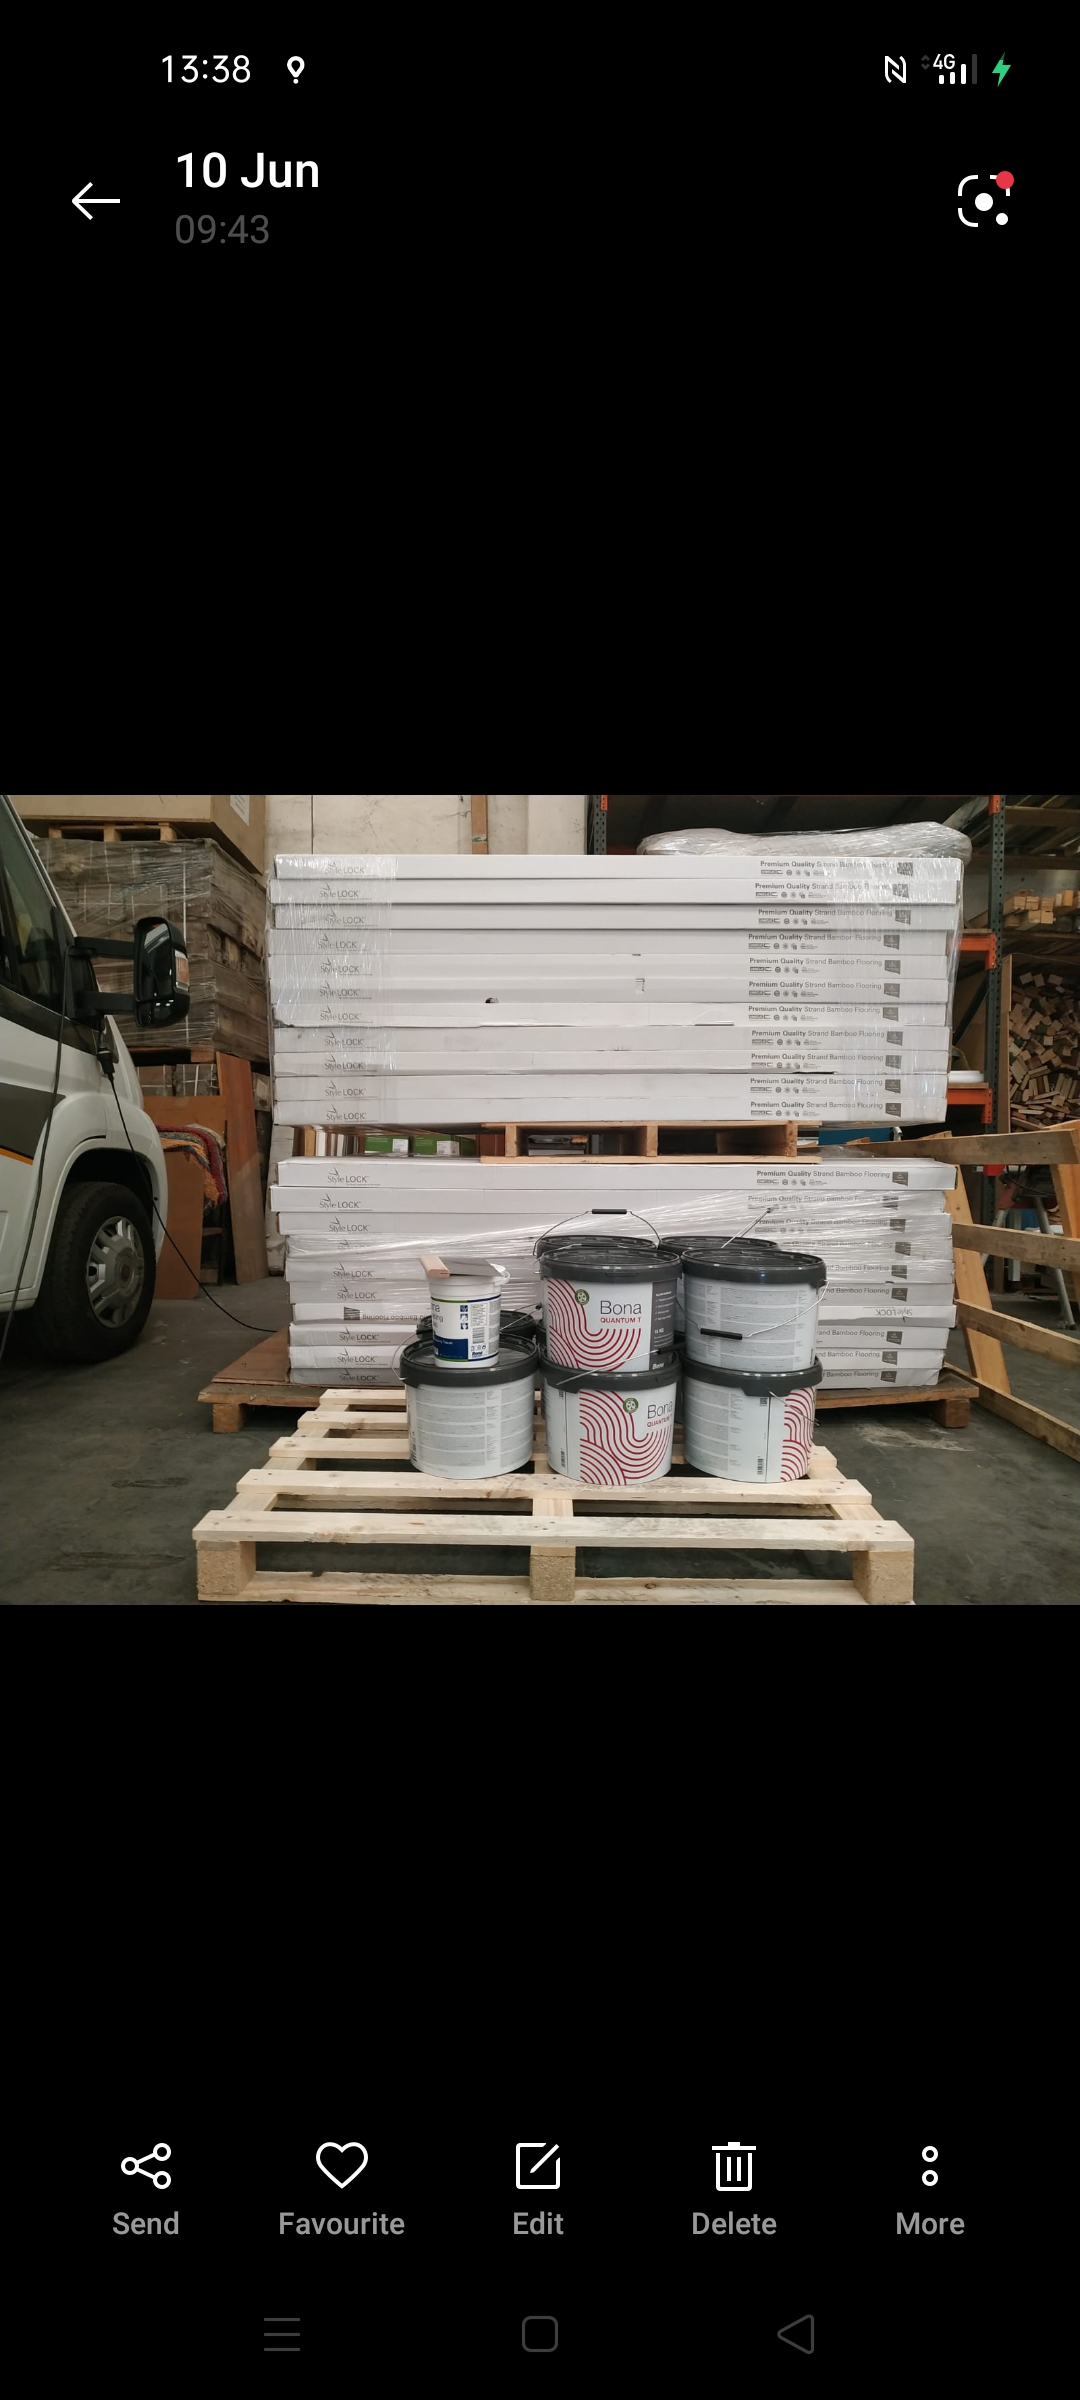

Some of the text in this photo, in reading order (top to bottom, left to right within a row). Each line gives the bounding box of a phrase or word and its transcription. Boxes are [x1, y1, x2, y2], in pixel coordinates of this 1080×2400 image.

[162, 55, 250, 83] 13:38
[932, 54, 955, 71] 4G
[178, 152, 318, 188] 10 Jun
[176, 215, 268, 243] 09:43
[600, 1300, 642, 1315] Bona
[647, 1401, 673, 1419] Bona
[113, 2211, 178, 2235] Send
[280, 2211, 404, 2235] Favourite
[514, 2210, 563, 2235] Edit
[693, 2210, 776, 2235] Delete
[897, 2211, 964, 2235] More
